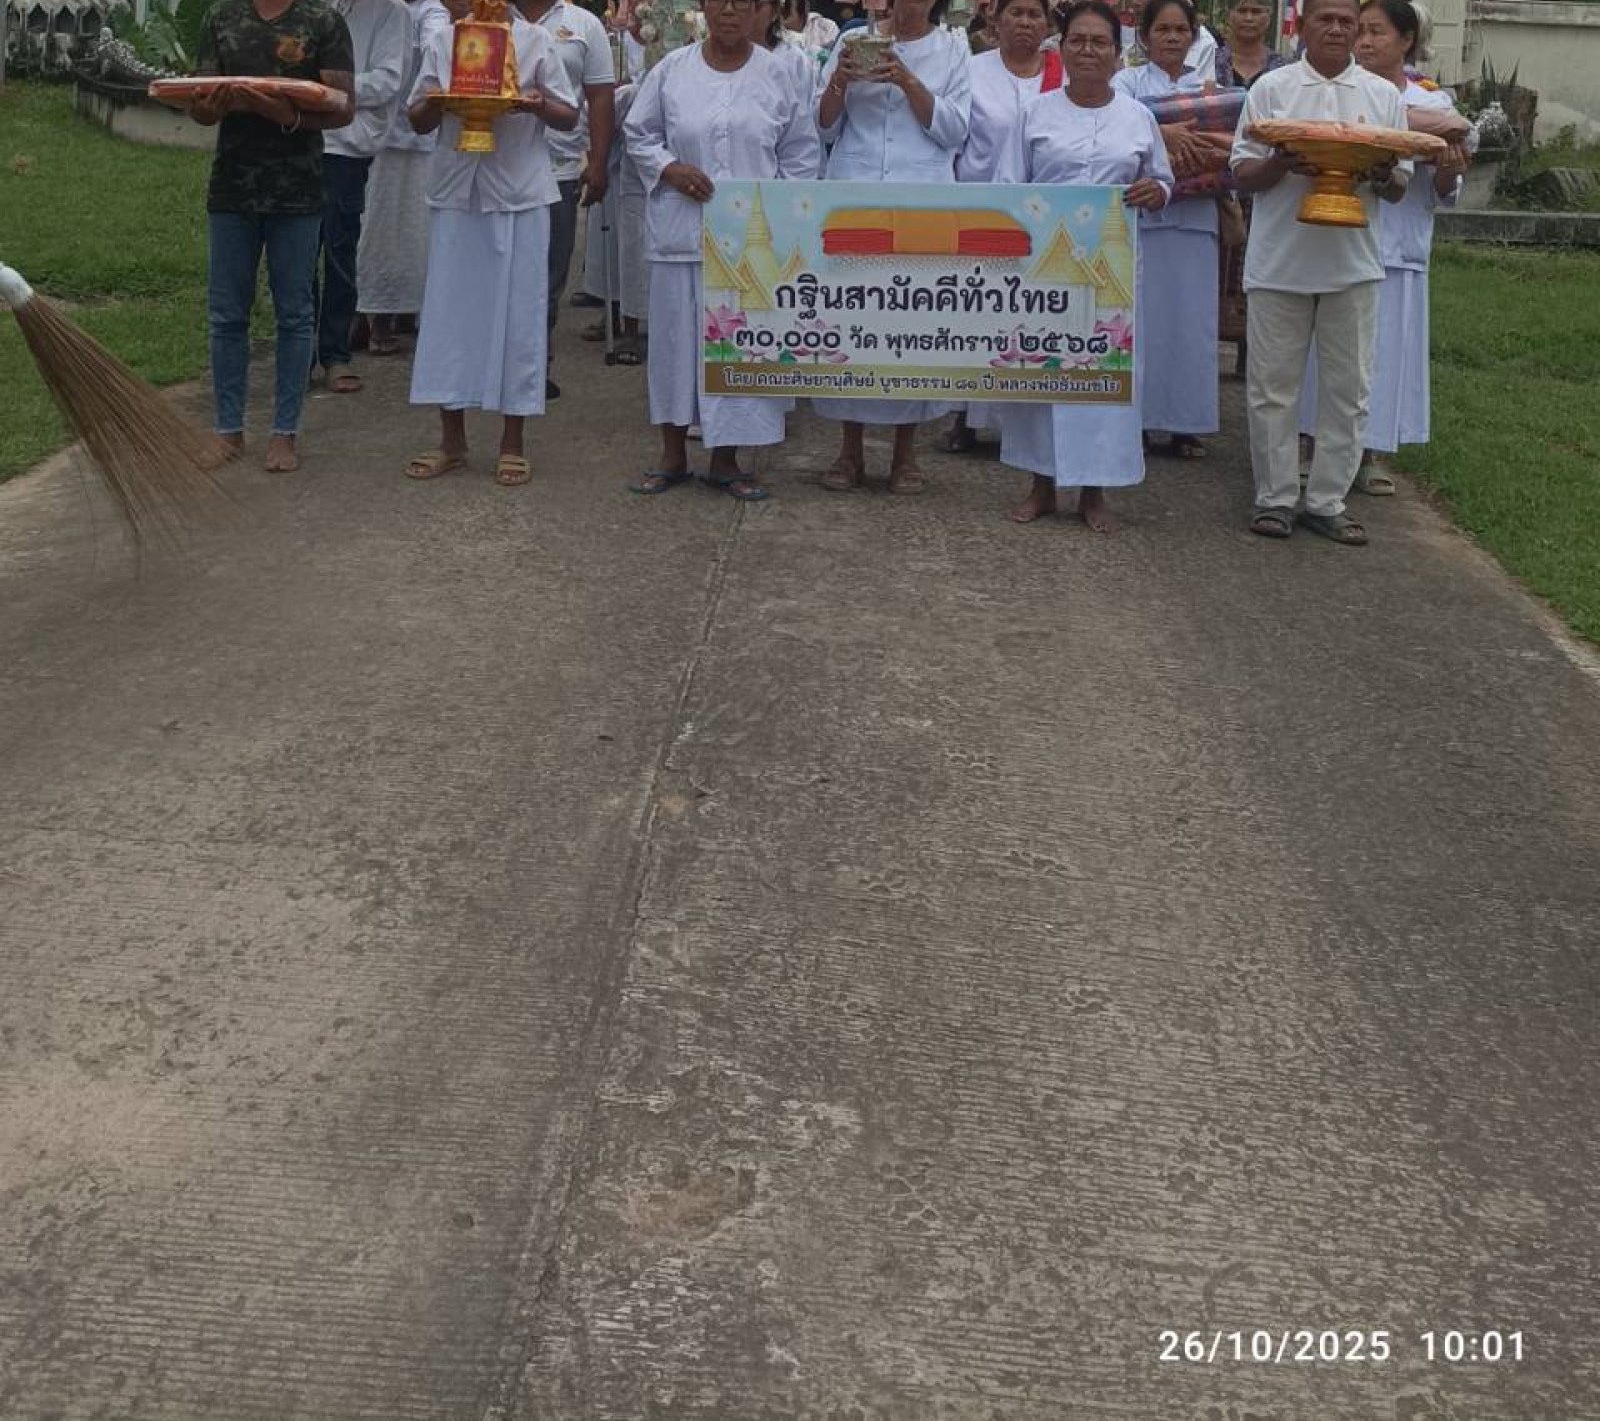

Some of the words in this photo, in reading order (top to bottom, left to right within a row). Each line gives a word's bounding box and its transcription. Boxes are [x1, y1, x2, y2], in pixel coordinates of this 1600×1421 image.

[775, 266, 1069, 320] กฐินสามัคคีทั่วไทย
[735, 328, 841, 352] ๓๐,๐๐๐
[849, 326, 878, 350] วัด
[886, 328, 1009, 358] พุทธศักราช
[1018, 331, 1109, 355] ๒๕๖๘
